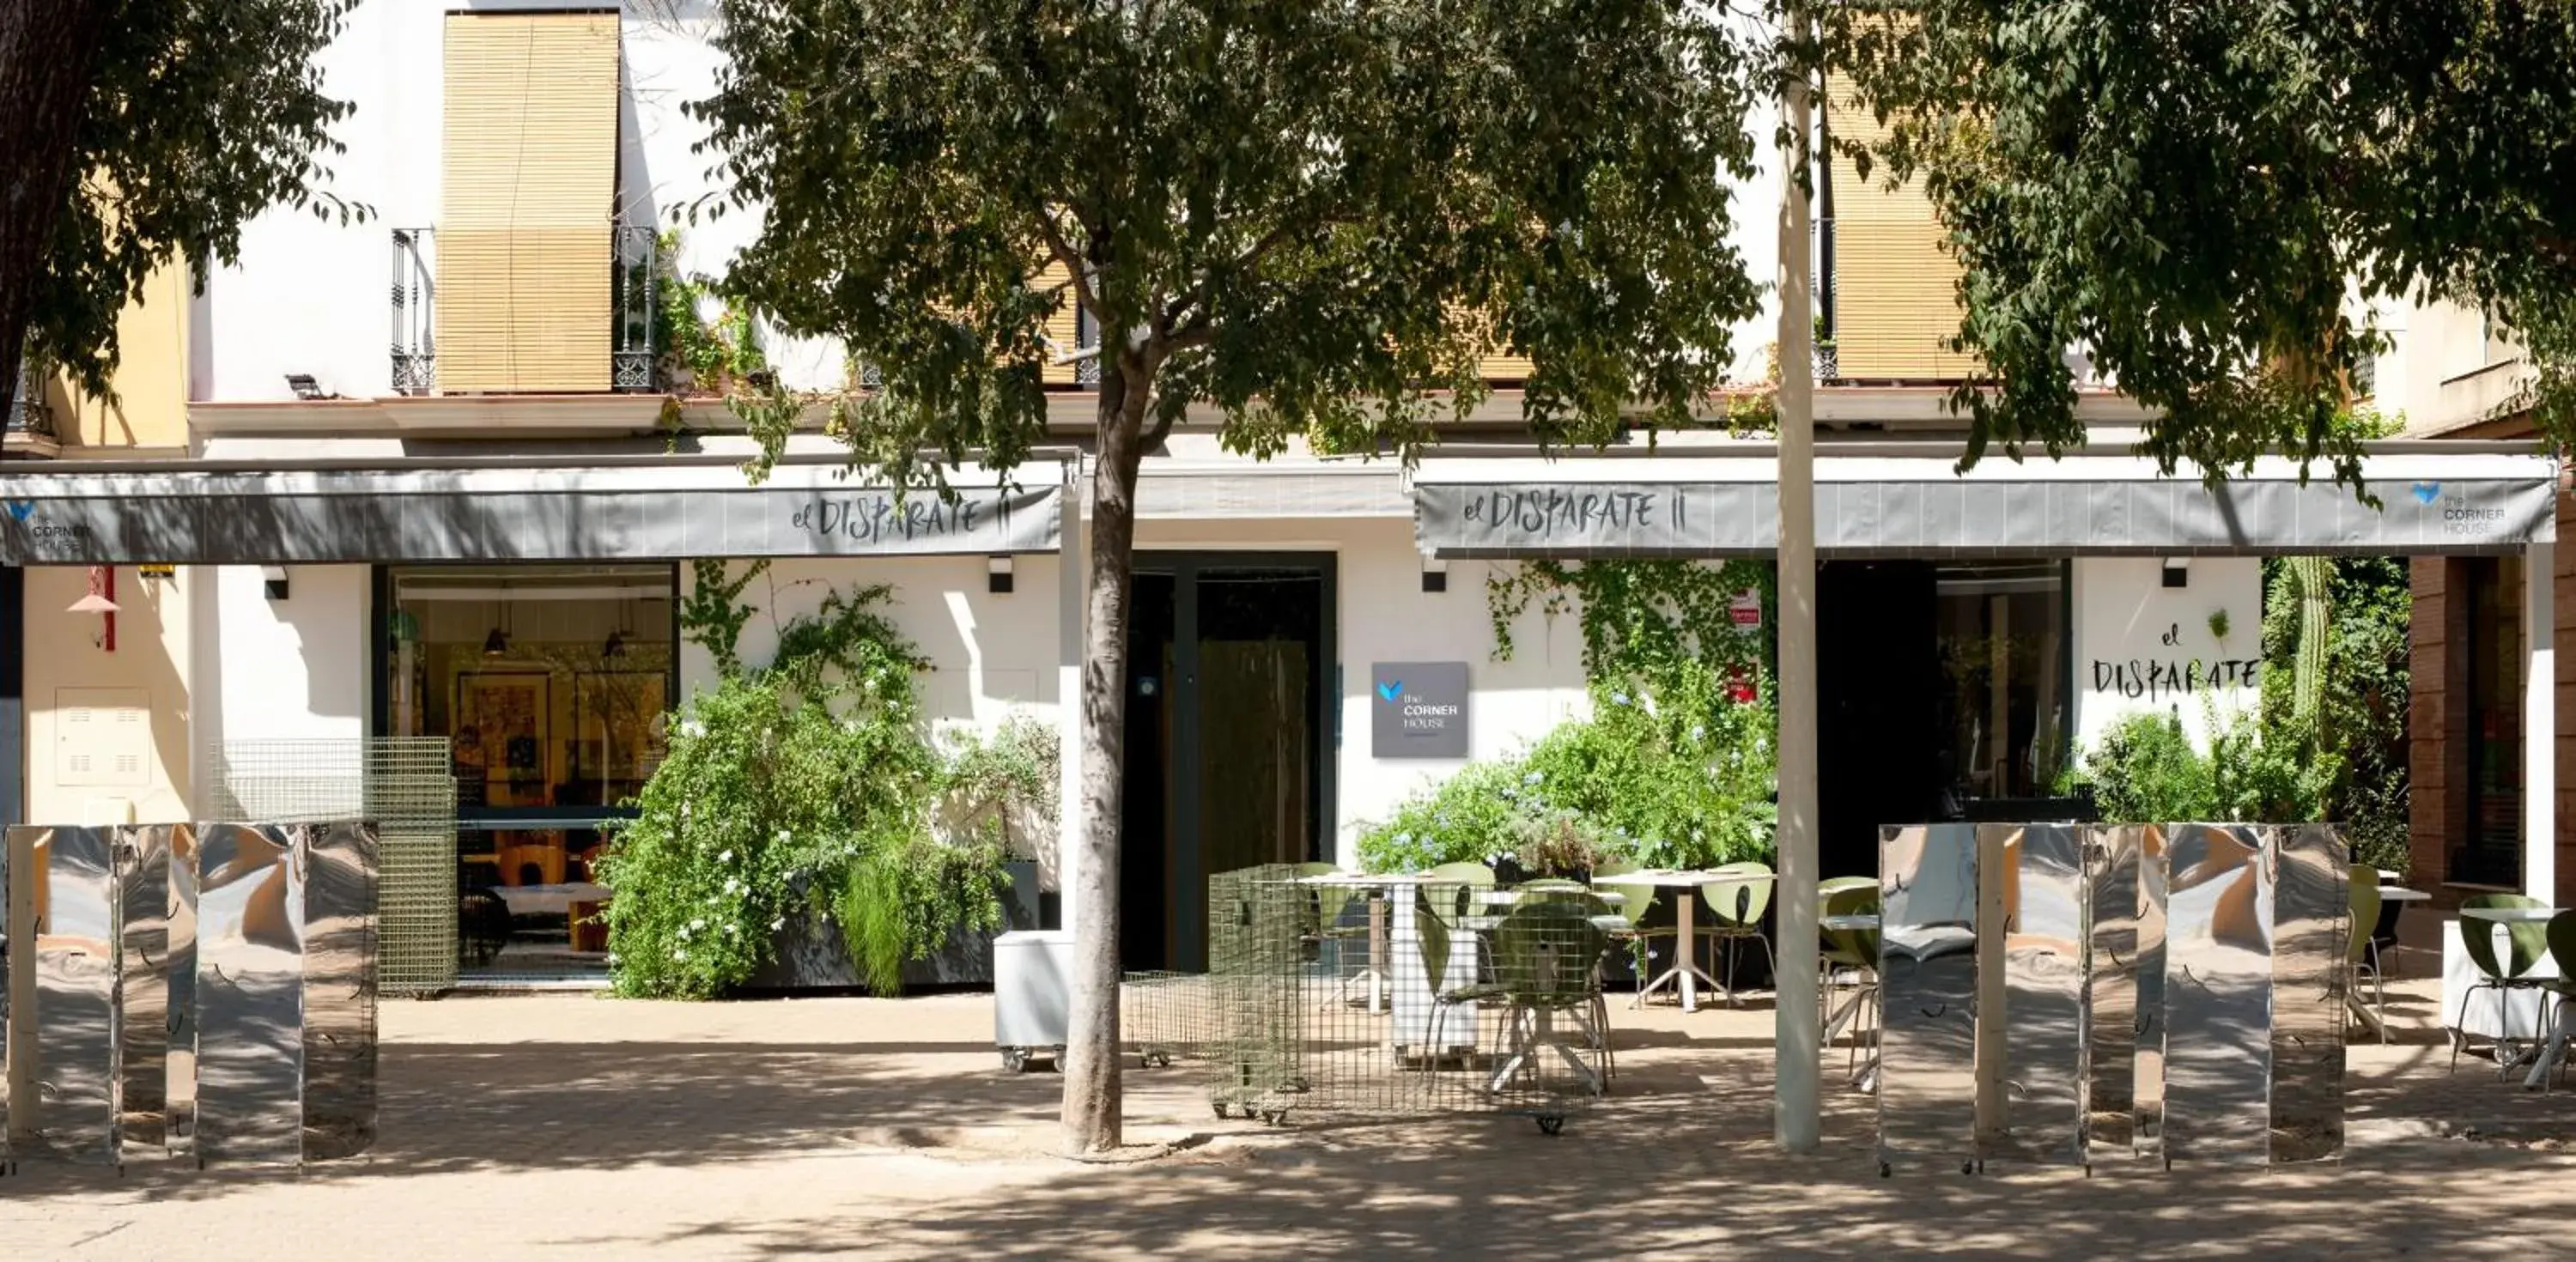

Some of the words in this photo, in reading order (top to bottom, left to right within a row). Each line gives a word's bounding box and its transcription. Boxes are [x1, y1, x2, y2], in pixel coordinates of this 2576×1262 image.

[2445, 496, 2464, 507] the
[792, 504, 812, 530] el
[1465, 495, 1484, 520] el
[1492, 488, 1656, 537] DISPARATE
[2445, 508, 2506, 521] CORNER
[2445, 523, 2493, 535] HOUSE
[2161, 622, 2181, 646] el
[1403, 693, 1422, 703] the
[1403, 705, 1458, 716] CORNER
[1403, 718, 1444, 729] HOUSE
